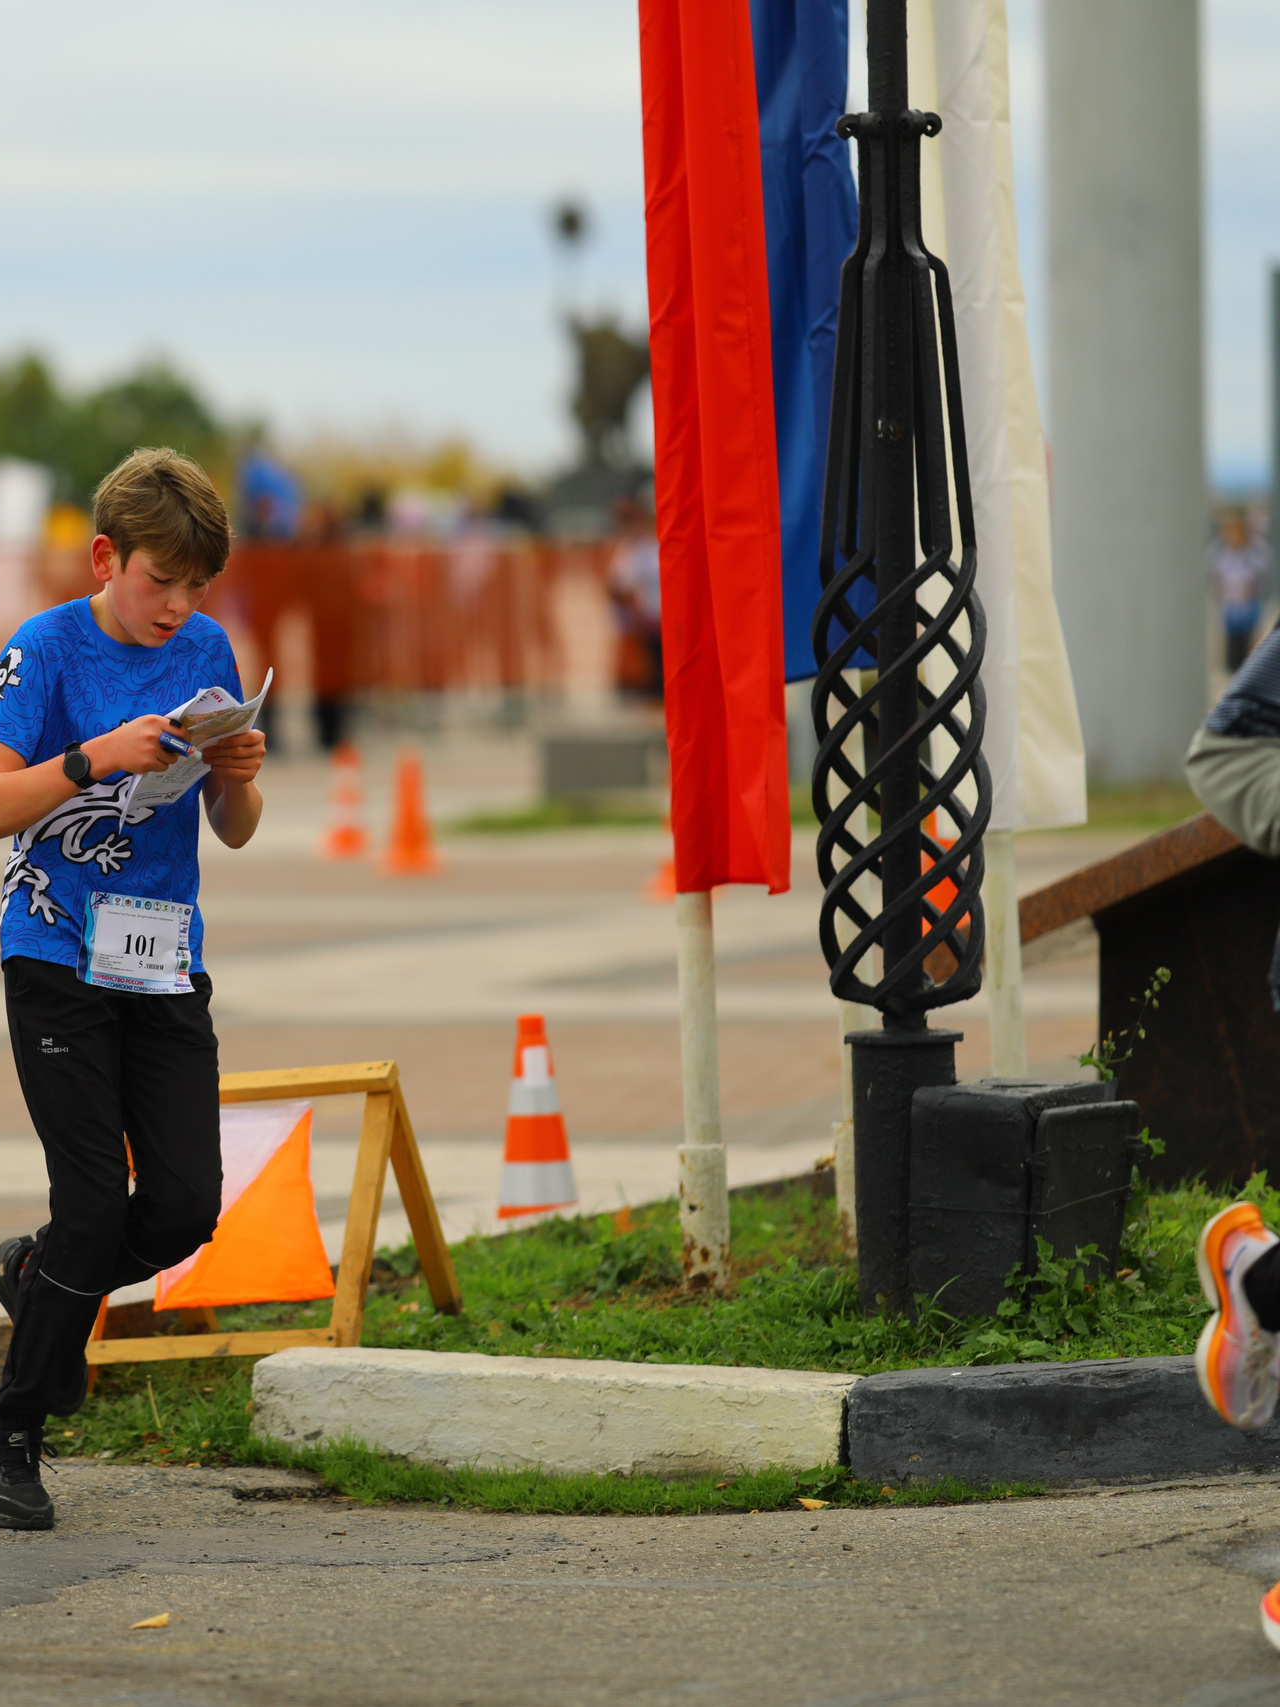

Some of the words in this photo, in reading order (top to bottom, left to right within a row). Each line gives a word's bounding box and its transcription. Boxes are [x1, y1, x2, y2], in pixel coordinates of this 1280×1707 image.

[123, 933, 156, 958] 101
[138, 960, 144, 969] 5
[144, 963, 165, 971] линия
[92, 972, 125, 984] ПЕРВЕНСТВО
[125, 978, 145, 986] РОССИИ
[133, 985, 170, 993] СОРЕВНОВАНИЯ
